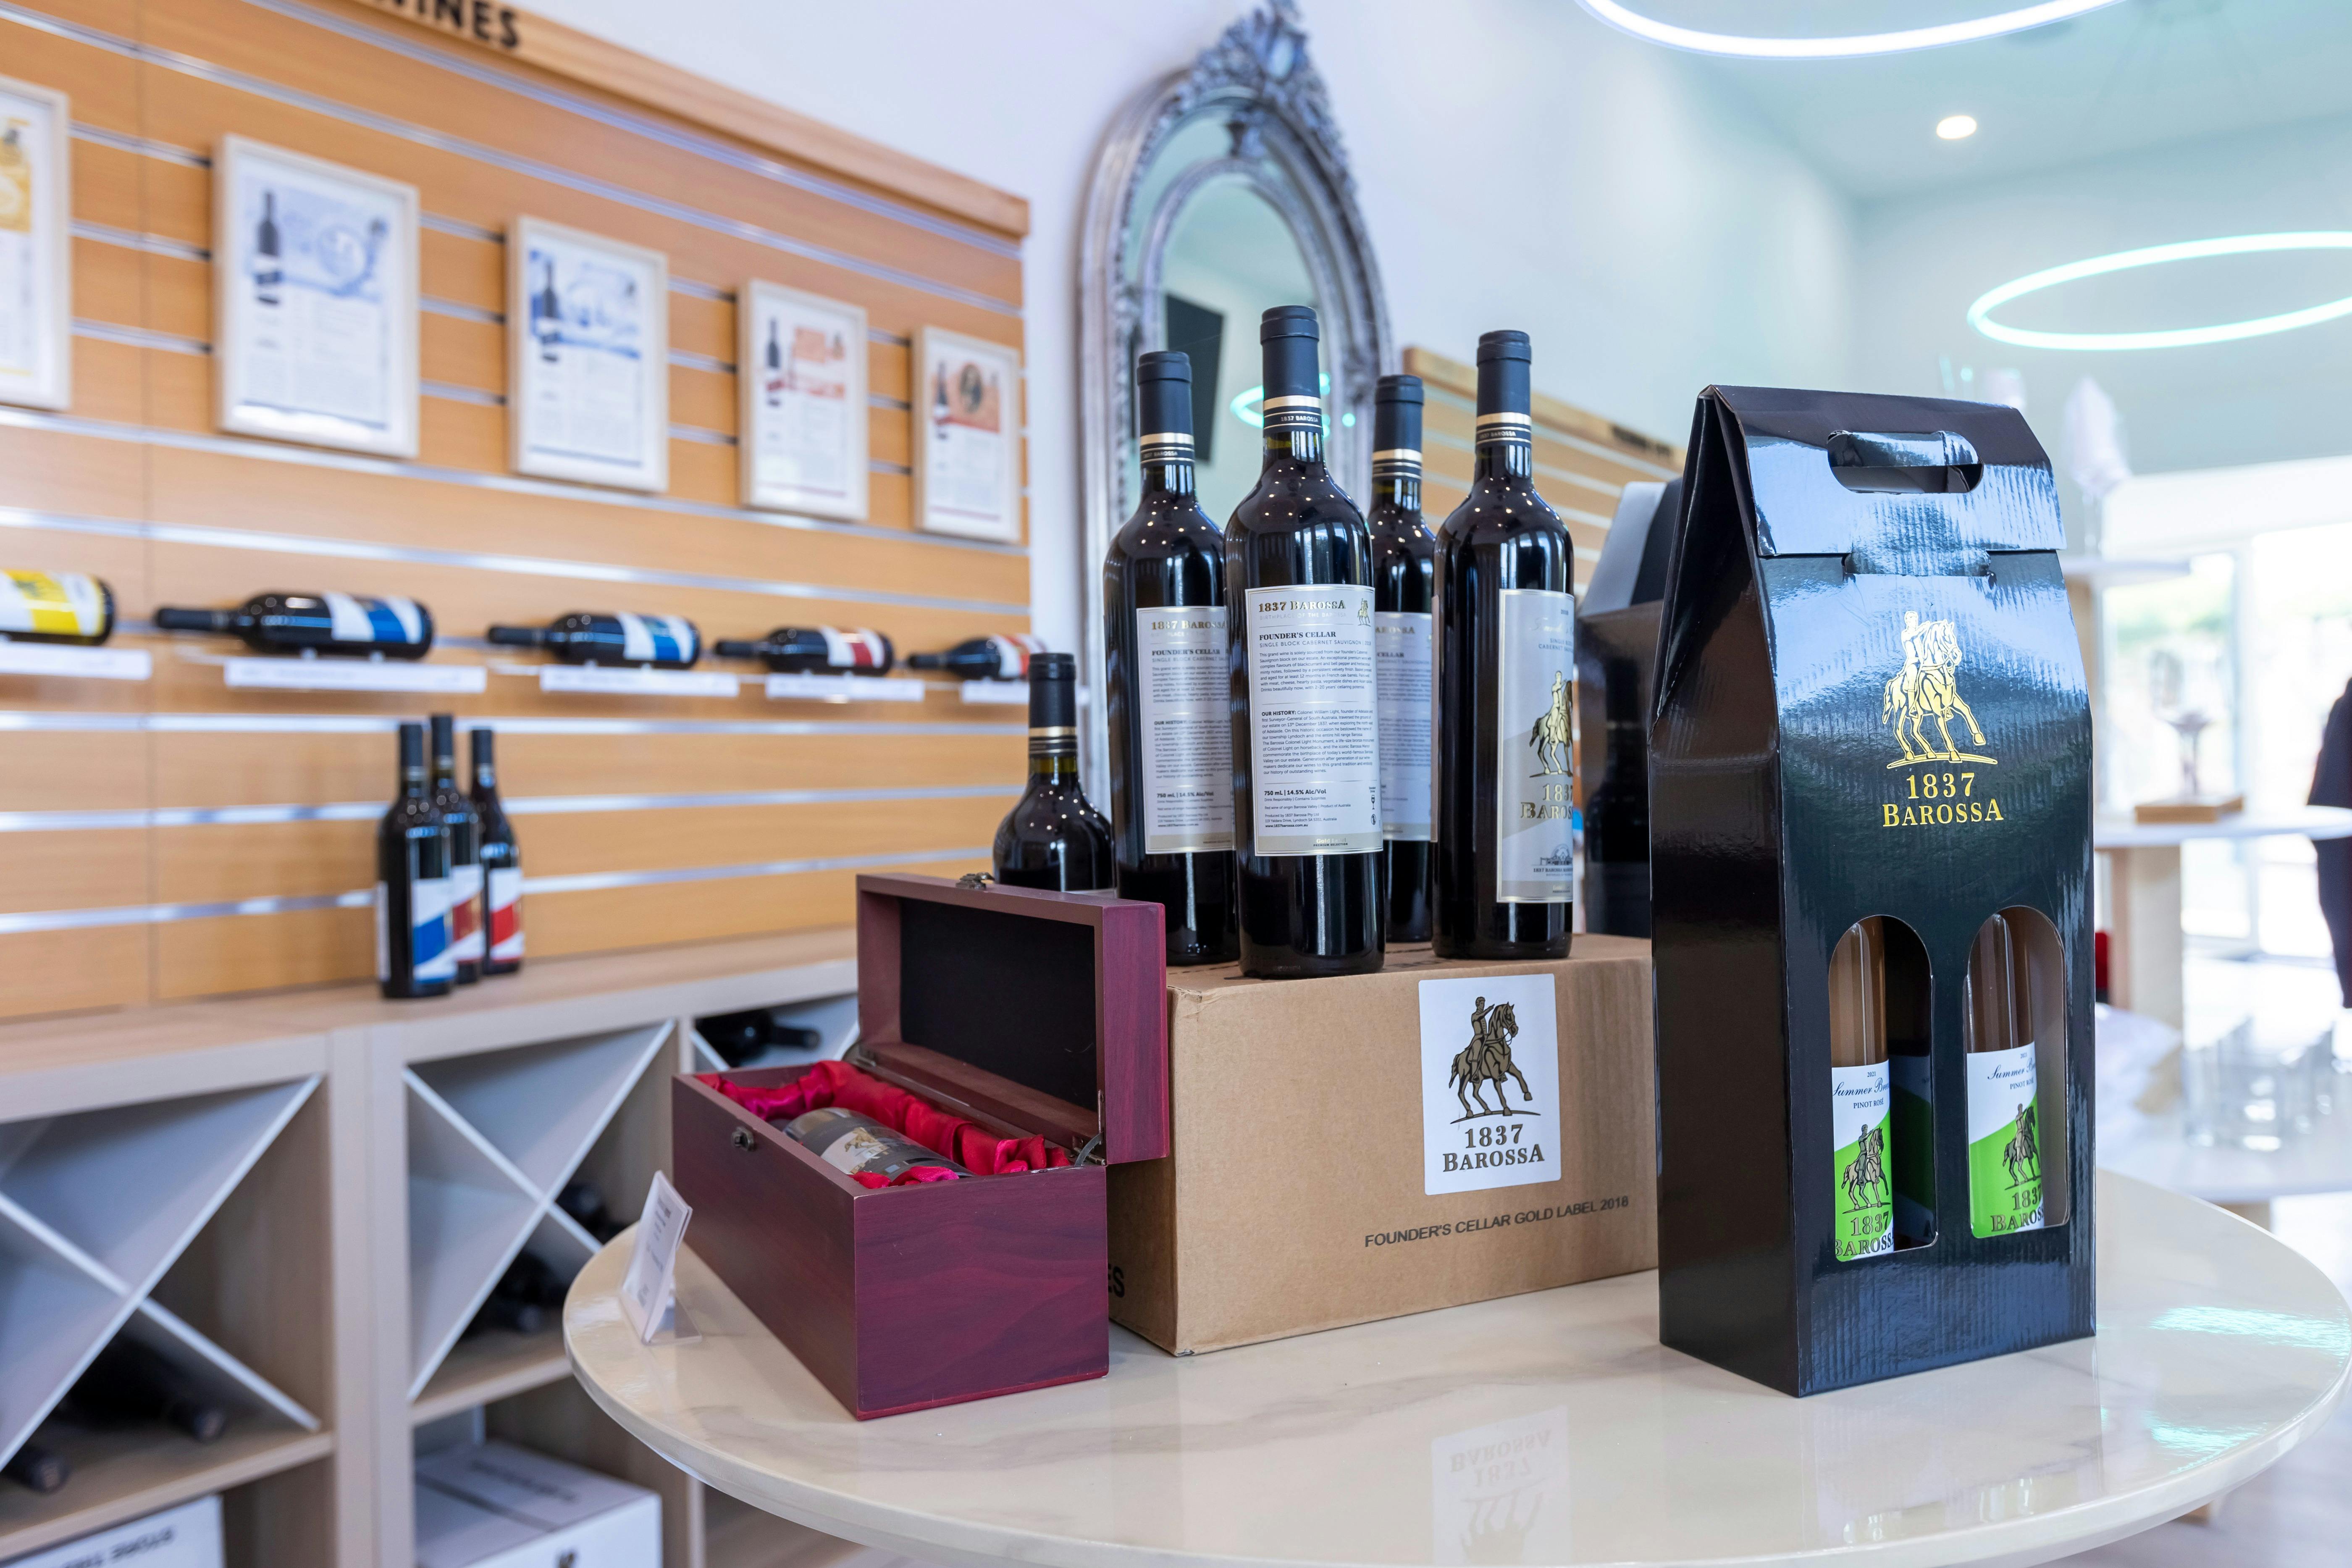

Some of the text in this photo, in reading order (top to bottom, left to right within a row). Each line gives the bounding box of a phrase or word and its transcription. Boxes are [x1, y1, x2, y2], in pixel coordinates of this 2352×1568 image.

[1259, 599, 1346, 612] 1837 BAROSSA
[1151, 620, 1178, 630] 1837
[1259, 632, 1303, 641] FOUNDER'S
[1906, 772, 1975, 799] 1837
[1520, 801, 1572, 819] BAROS
[1882, 798, 2004, 827] BAROSSA
[1987, 1064, 2025, 1079] Summer
[1832, 1082, 1872, 1096] Summer
[2010, 1081, 2025, 1090] PINOT
[1853, 1097, 1884, 1109] PINOT ROSÉ
[1465, 1124, 1524, 1149] 1837
[1443, 1144, 1545, 1172] BAROSSA
[2011, 1183, 2042, 1211] 1837
[1364, 1195, 1629, 1248] FOUNDER'S CELLAR GOLD LABEL 2018
[1851, 1211, 1889, 1236] 1837
[1990, 1206, 2043, 1232] BAROSS
